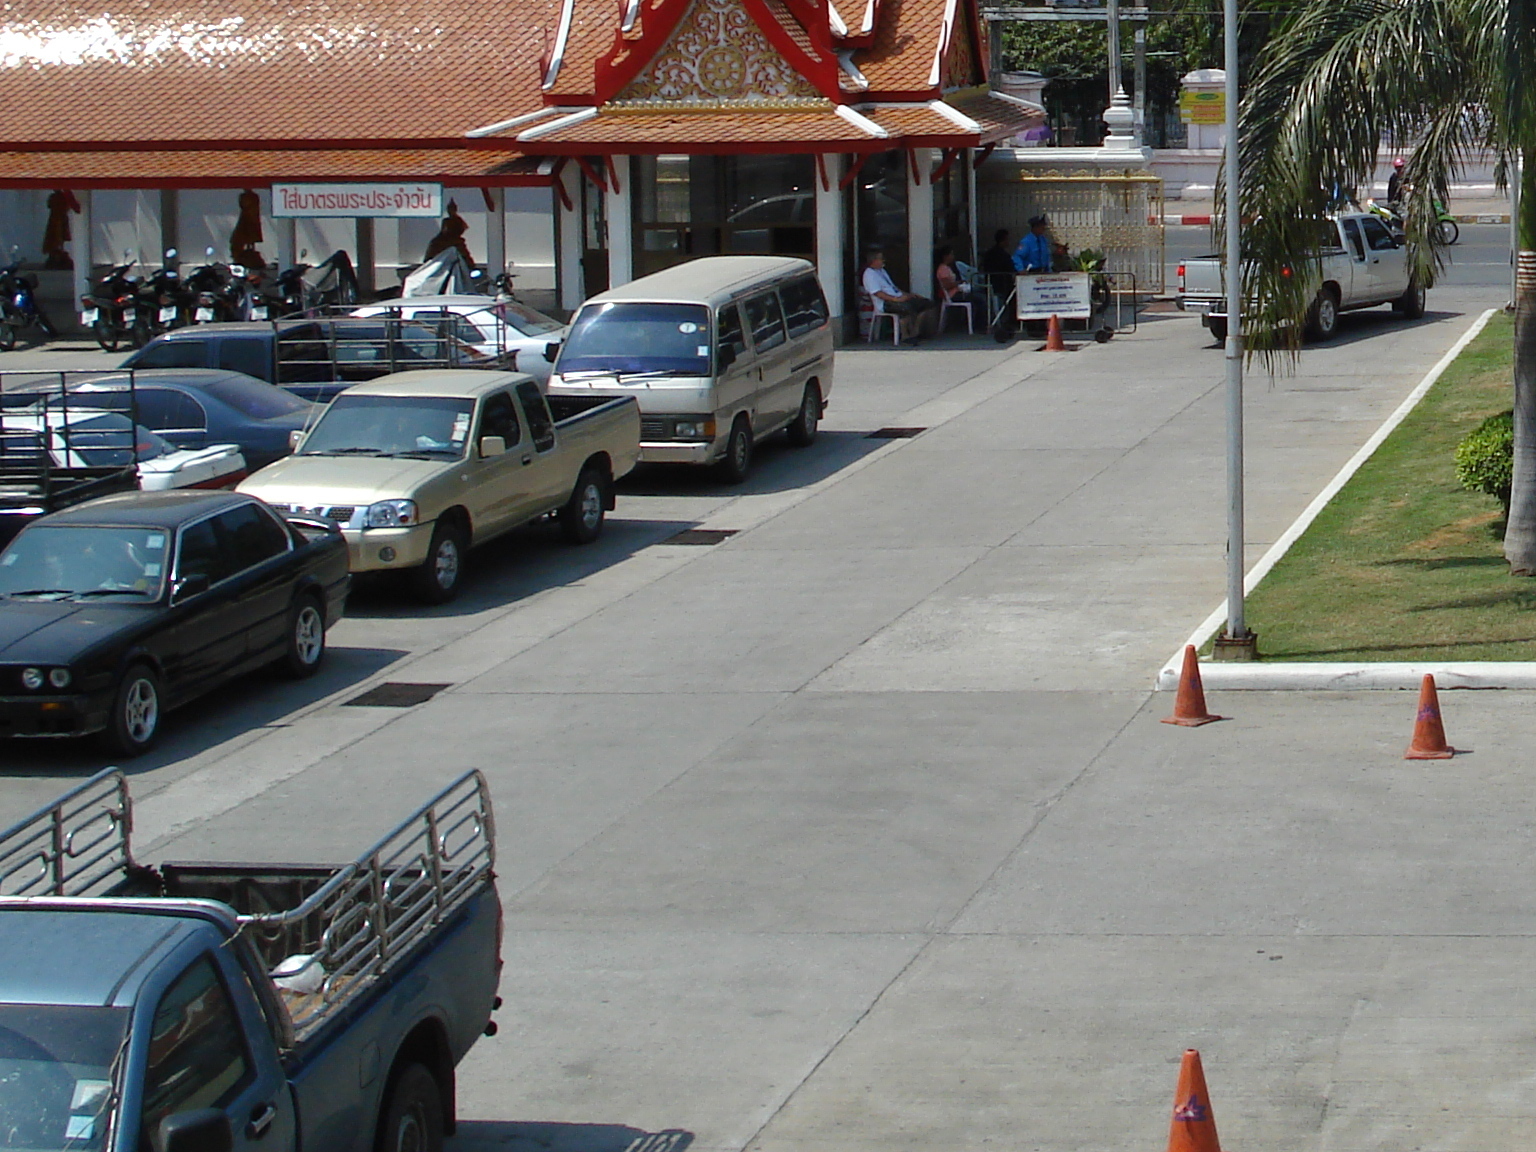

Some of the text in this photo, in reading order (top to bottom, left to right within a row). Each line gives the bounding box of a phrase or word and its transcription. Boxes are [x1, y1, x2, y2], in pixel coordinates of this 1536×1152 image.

[280, 187, 431, 209] ใส่บาตรพระประจำวัน
